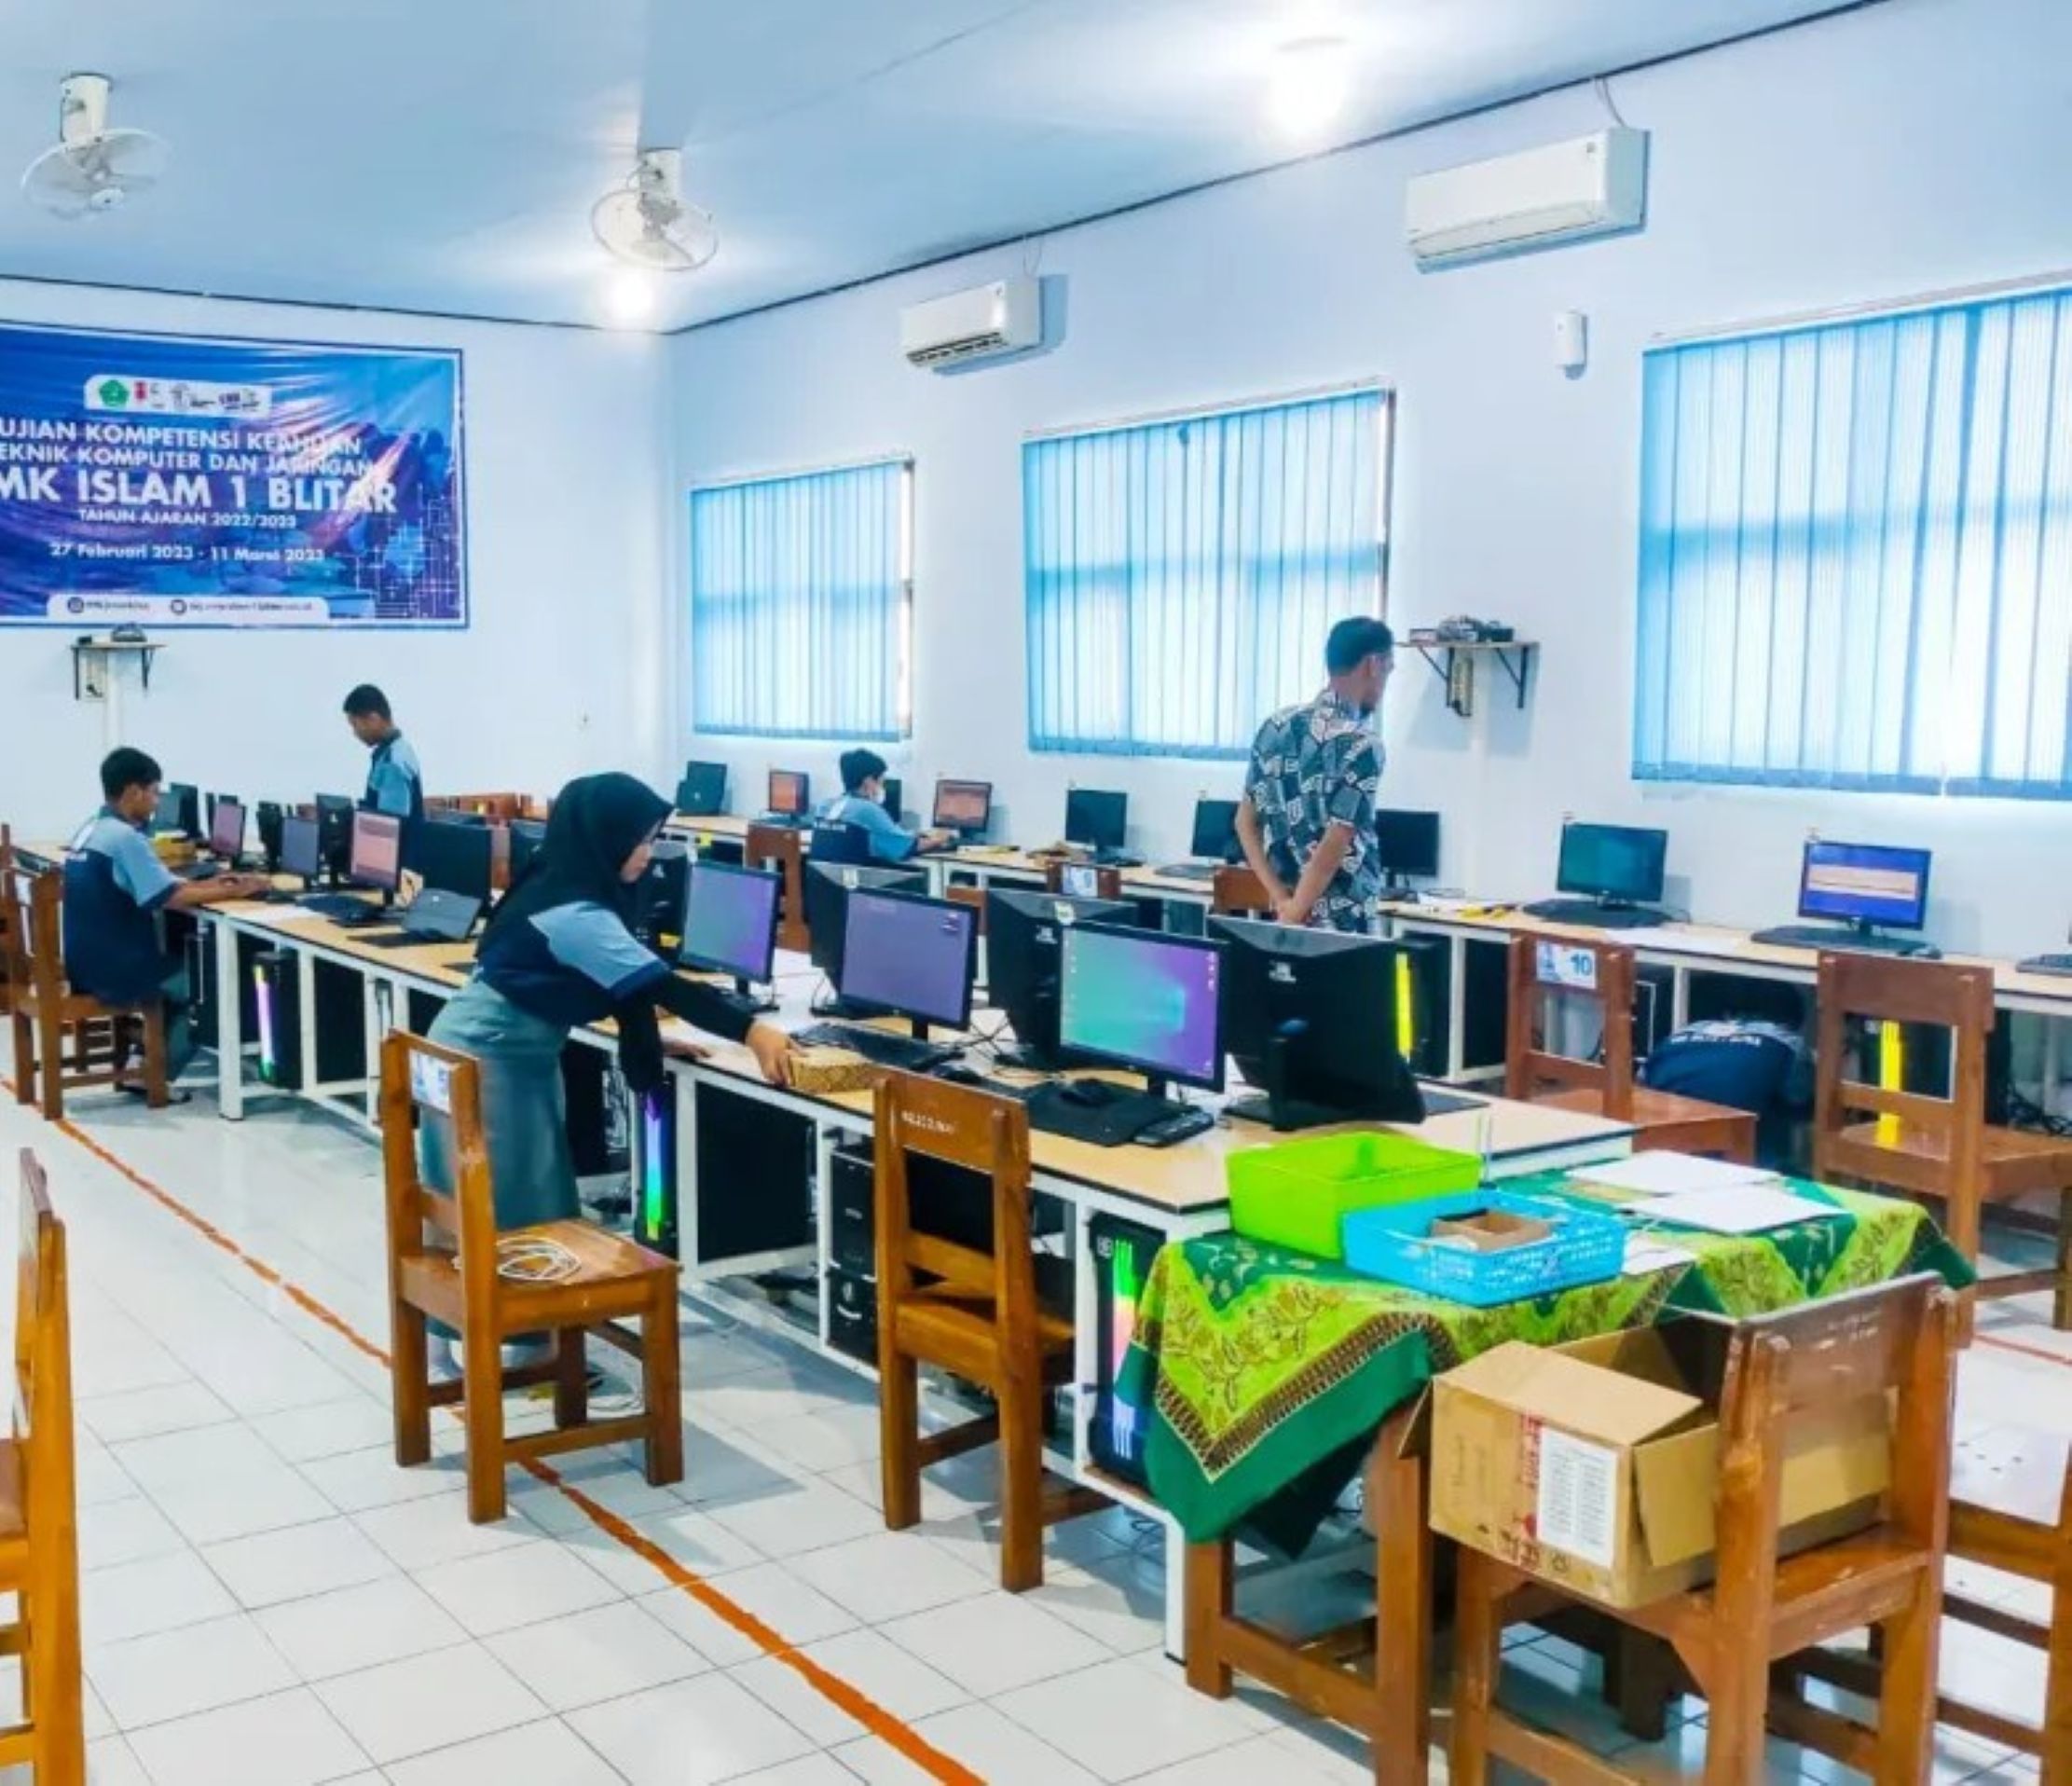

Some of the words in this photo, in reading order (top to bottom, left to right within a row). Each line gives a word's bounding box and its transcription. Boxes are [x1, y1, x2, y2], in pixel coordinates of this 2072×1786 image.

[0, 417, 76, 441] UJIAN
[86, 424, 238, 449] KOMPETENSI
[248, 432, 361, 454] KEAHLAN
[0, 443, 68, 463] EKNIK
[77, 446, 200, 469] KOMPUTER
[210, 454, 257, 473] DAN
[0, 466, 62, 502] MK
[77, 468, 212, 508] ISLAM
[230, 474, 246, 509] 1
[268, 476, 396, 513] BLITAR
[79, 508, 135, 523] TAHUN
[142, 511, 206, 525] AJARAN
[49, 541, 72, 556] 27
[78, 543, 148, 558] Februari
[152, 545, 194, 559] 2023
[212, 546, 227, 560] 11
[1571, 954, 1593, 976] 10
